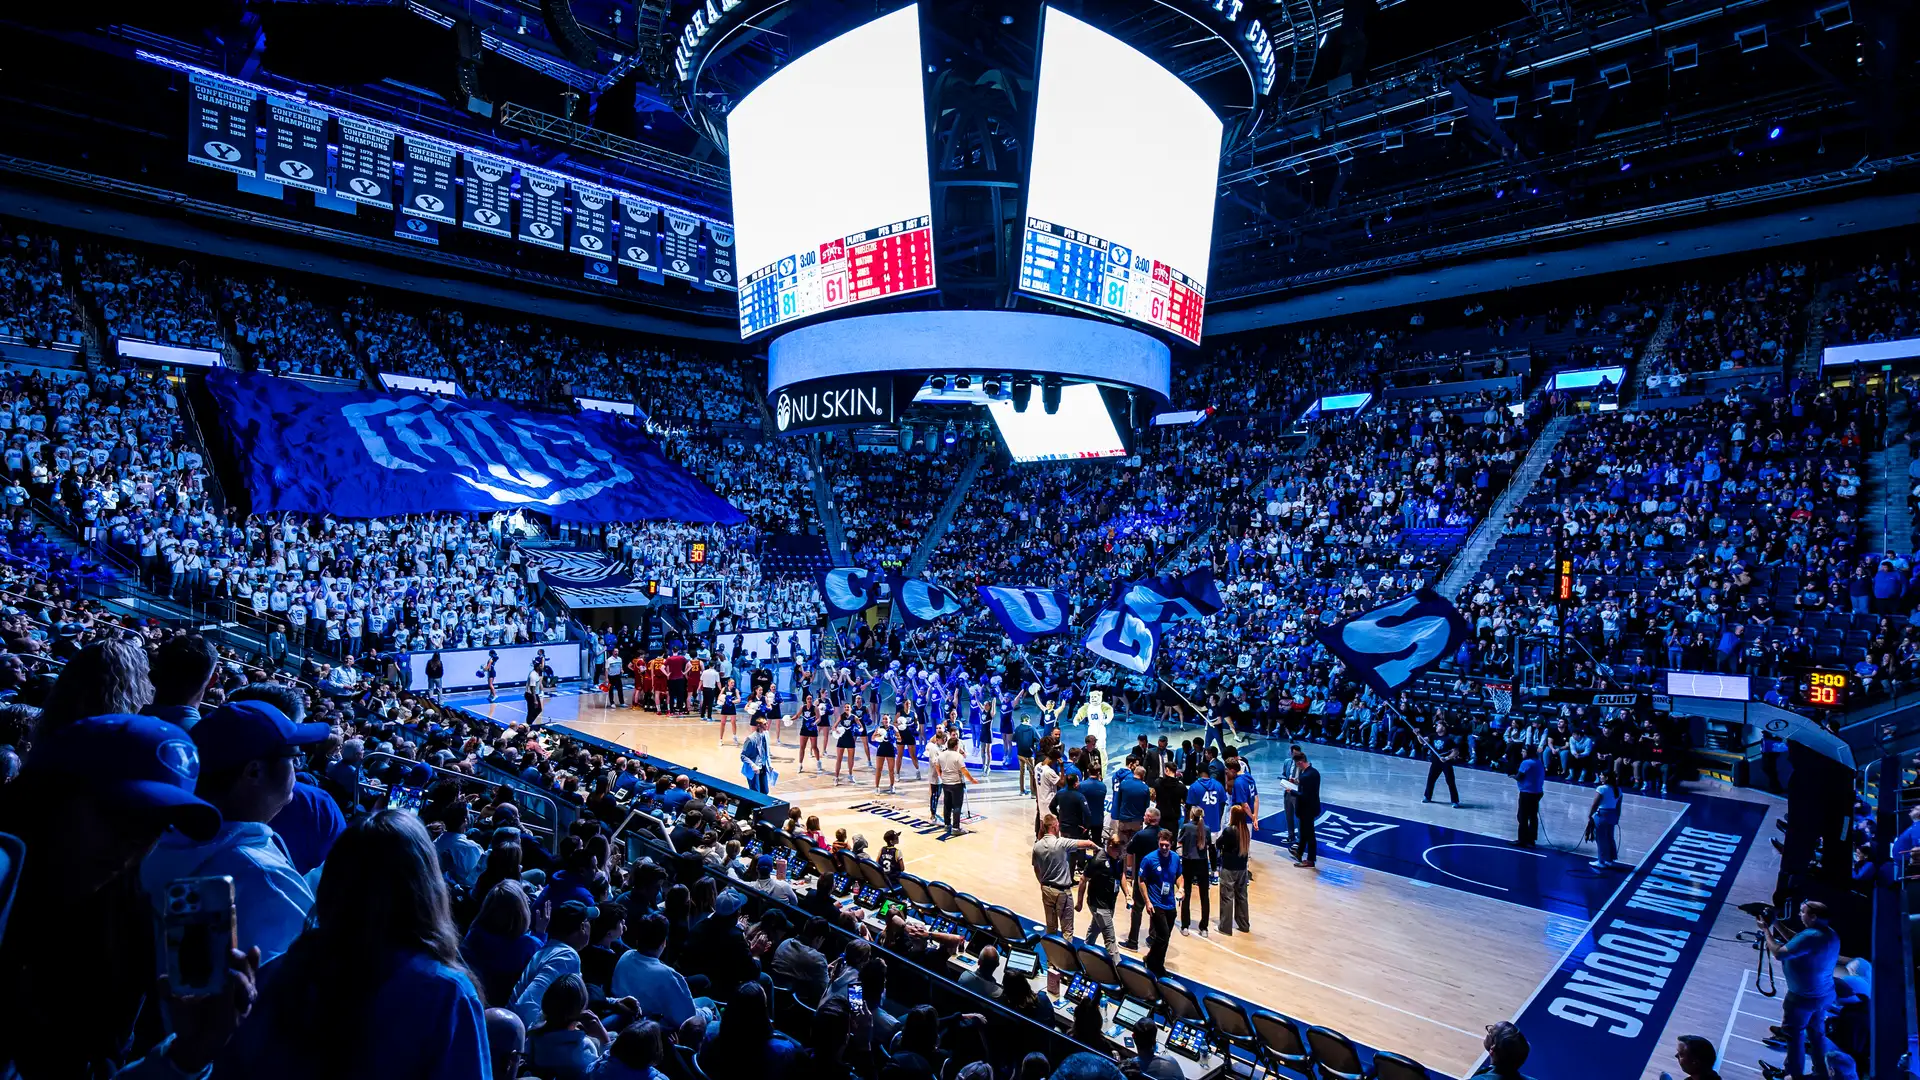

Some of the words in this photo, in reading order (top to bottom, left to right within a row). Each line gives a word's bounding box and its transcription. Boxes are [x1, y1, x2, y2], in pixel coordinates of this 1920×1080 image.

[194, 77, 215, 87] ROCKY
[218, 83, 252, 97] MOUNTAIN
[195, 85, 251, 106] CONFERENCE
[197, 93, 249, 112] CHAMPIONS
[202, 115, 218, 123] 1924
[272, 106, 323, 126] CONFERENCE
[274, 114, 321, 132] CHAMPIONS
[202, 122, 218, 130] 1925
[230, 130, 246, 138] 1934
[278, 128, 293, 136] 1943
[343, 128, 390, 145] CONFERENCE
[344, 134, 388, 151] CHAMPIONS
[408, 138, 436, 150] MOUNTAIN
[408, 146, 452, 162] CONFERENCE
[410, 152, 450, 168] CHAMPIONS
[189, 157, 210, 167] MEN'S
[212, 163, 255, 177] BASKETBALL
[470, 156, 506, 170] TOURNAMENT
[477, 164, 502, 177] NCAA
[266, 176, 286, 184] MEN'S
[287, 181, 326, 194] BASKETBALL
[532, 180, 555, 192] NCAA
[356, 196, 392, 210] BASKETBALL
[582, 194, 604, 206] NCAA
[422, 213, 455, 224] BASKETBALL
[630, 208, 650, 218] NCAA
[480, 227, 511, 238] BASKETBALL
[674, 220, 690, 232] NIT
[847, 233, 866, 246] PLAYER
[878, 226, 890, 236] PTS
[892, 223, 904, 233] REB
[906, 219, 918, 230] AST
[920, 216, 928, 226] PF
[1029, 218, 1052, 232] PLAYER
[1064, 228, 1074, 239] PTS
[1076, 232, 1088, 242] REB
[1089, 236, 1100, 246] AST
[1100, 240, 1108, 250] PF
[716, 232, 730, 242] NIT
[800, 250, 816, 268] 3:00
[822, 246, 842, 260] STATE
[897, 248, 902, 256] 2
[912, 256, 916, 264] 2
[924, 253, 930, 262] 4
[1135, 256, 1150, 274] 3:00
[884, 274, 890, 282] 14
[898, 270, 903, 279] 4
[926, 265, 930, 274] 2
[826, 276, 843, 302] 61
[850, 292, 856, 301] 22
[1108, 282, 1124, 308] 81
[782, 291, 796, 315] 81
[1152, 297, 1164, 320] 61
[792, 393, 817, 424] NU
[690, 550, 702, 562] 30
[825, 567, 868, 611] C
[987, 585, 1063, 633] U
[1342, 596, 1450, 689] S
[692, 664, 699, 672] 23
[1811, 672, 1844, 686] 3:00
[1598, 695, 1636, 704] BUILT
[1810, 686, 1834, 702] 30
[169, 742, 199, 774] Y
[1202, 791, 1218, 804] 45
[882, 860, 891, 872] 3
[1625, 826, 1742, 923] BRIGHAM
[1547, 918, 1691, 1039] YOUNG
